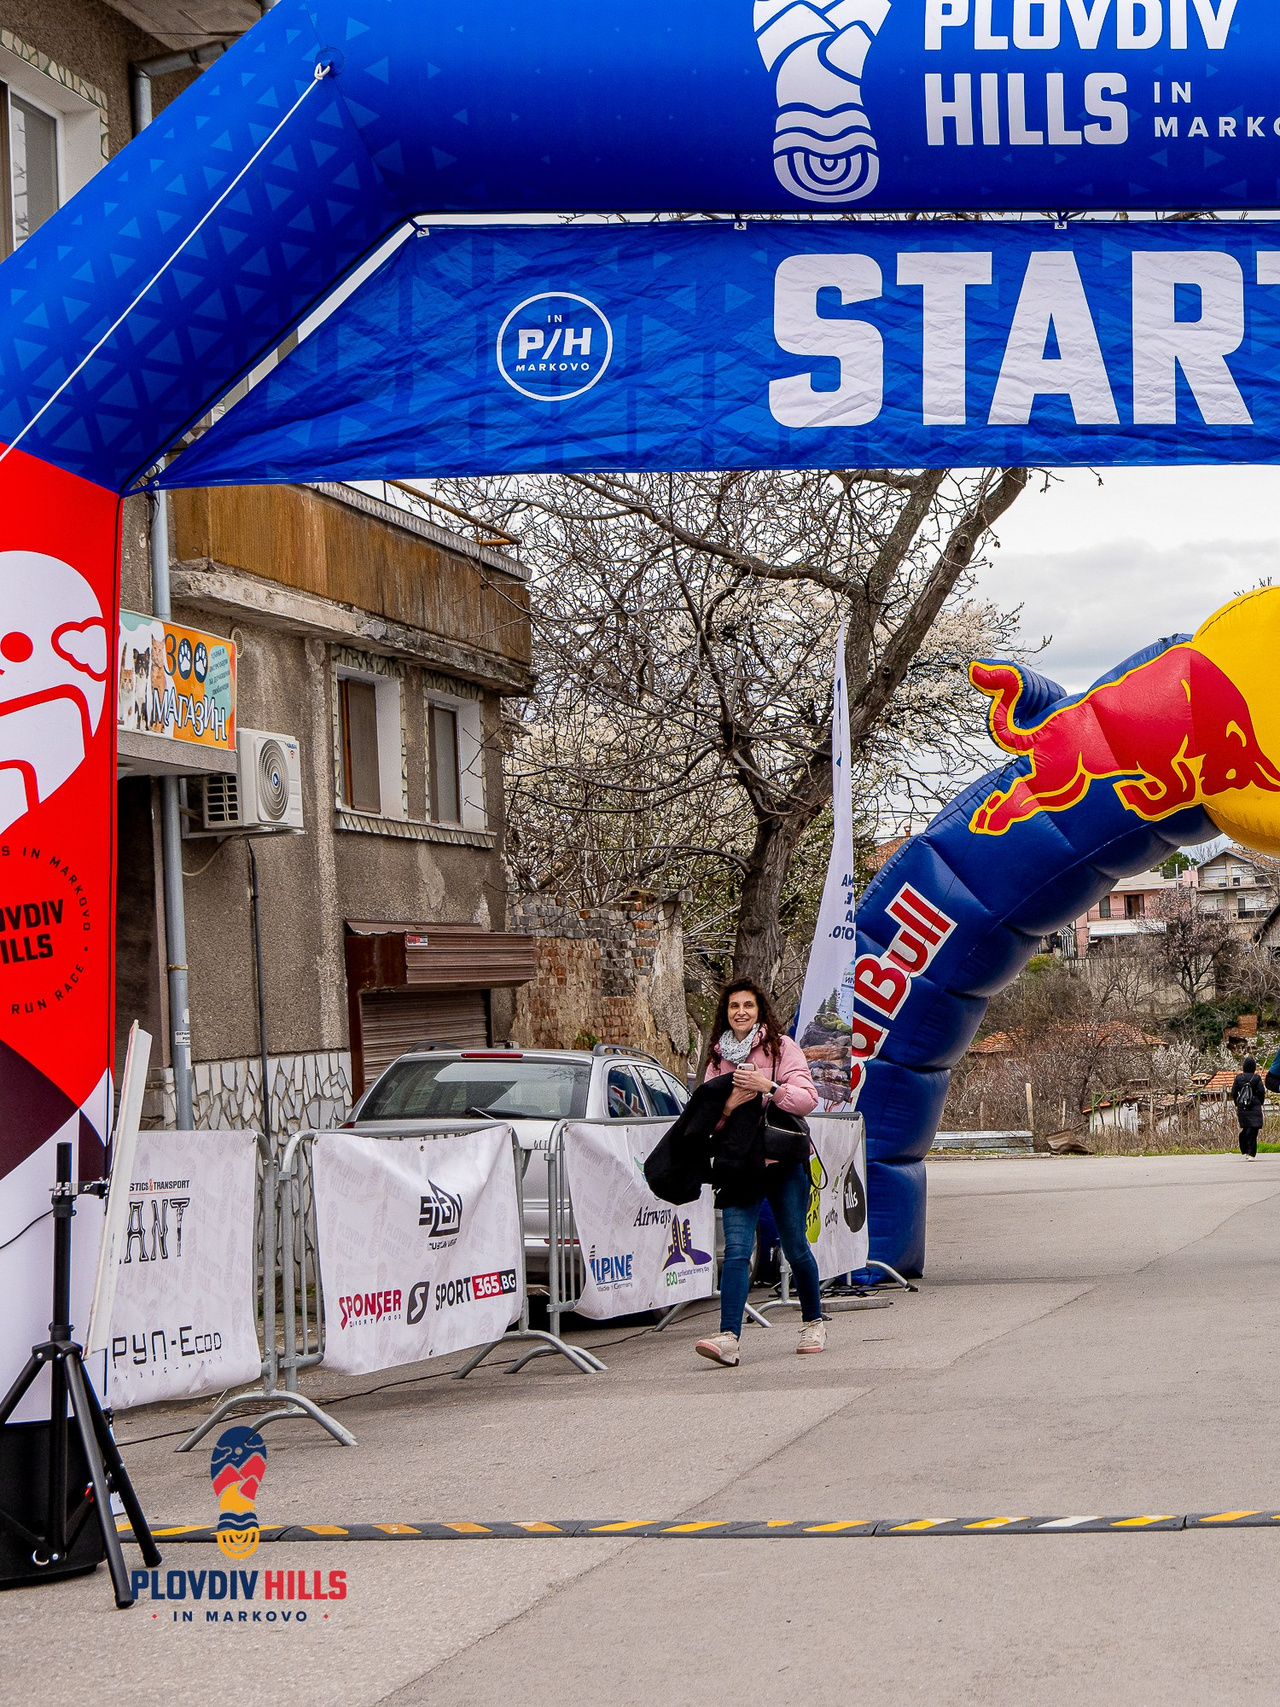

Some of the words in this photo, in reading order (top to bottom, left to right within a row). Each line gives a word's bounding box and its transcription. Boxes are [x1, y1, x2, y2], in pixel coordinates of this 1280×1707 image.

[924, 0, 1238, 50] PLOVDIV
[924, 72, 1128, 146] HILLS
[1153, 81, 1191, 103] IN
[548, 314, 562, 323] IN
[518, 327, 592, 360] P/H
[515, 362, 590, 372] MARKOVO
[153, 687, 227, 741] МАГАЗИН
[23, 847, 41, 859] IN
[49, 856, 91, 931] MARKOVO
[0, 934, 53, 964] ILLS
[855, 884, 955, 1018] Bull
[11, 999, 47, 1014] RUN
[54, 963, 84, 1001] RACE
[119, 1198, 190, 1264] ANT
[633, 1206, 672, 1229] Airways
[666, 1271, 678, 1287] ECO
[339, 1289, 402, 1330] SPONSER
